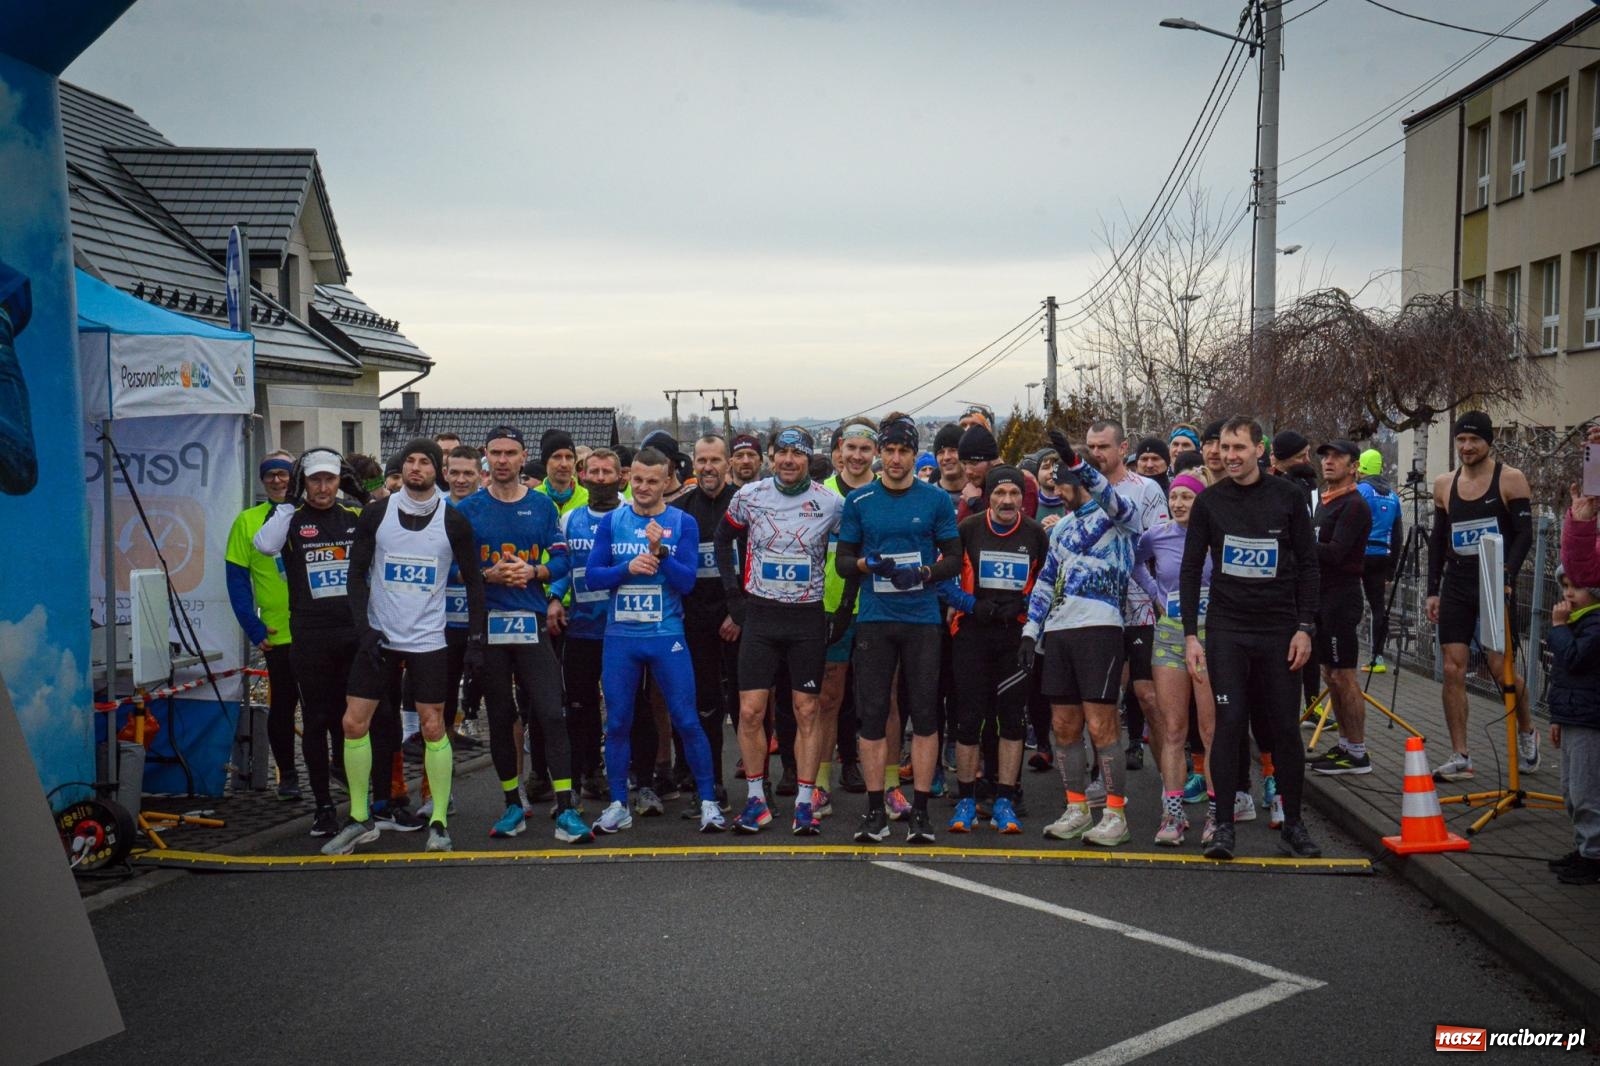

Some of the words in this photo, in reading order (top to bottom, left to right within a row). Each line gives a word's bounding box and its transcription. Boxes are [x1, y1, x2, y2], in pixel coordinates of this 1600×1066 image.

[1231, 548, 1269, 566] 220
[318, 569, 349, 587] 155
[393, 565, 428, 583] 134
[775, 564, 797, 580] 16
[993, 562, 1015, 578] 31
[623, 595, 654, 611] 114
[503, 618, 526, 633] 74
